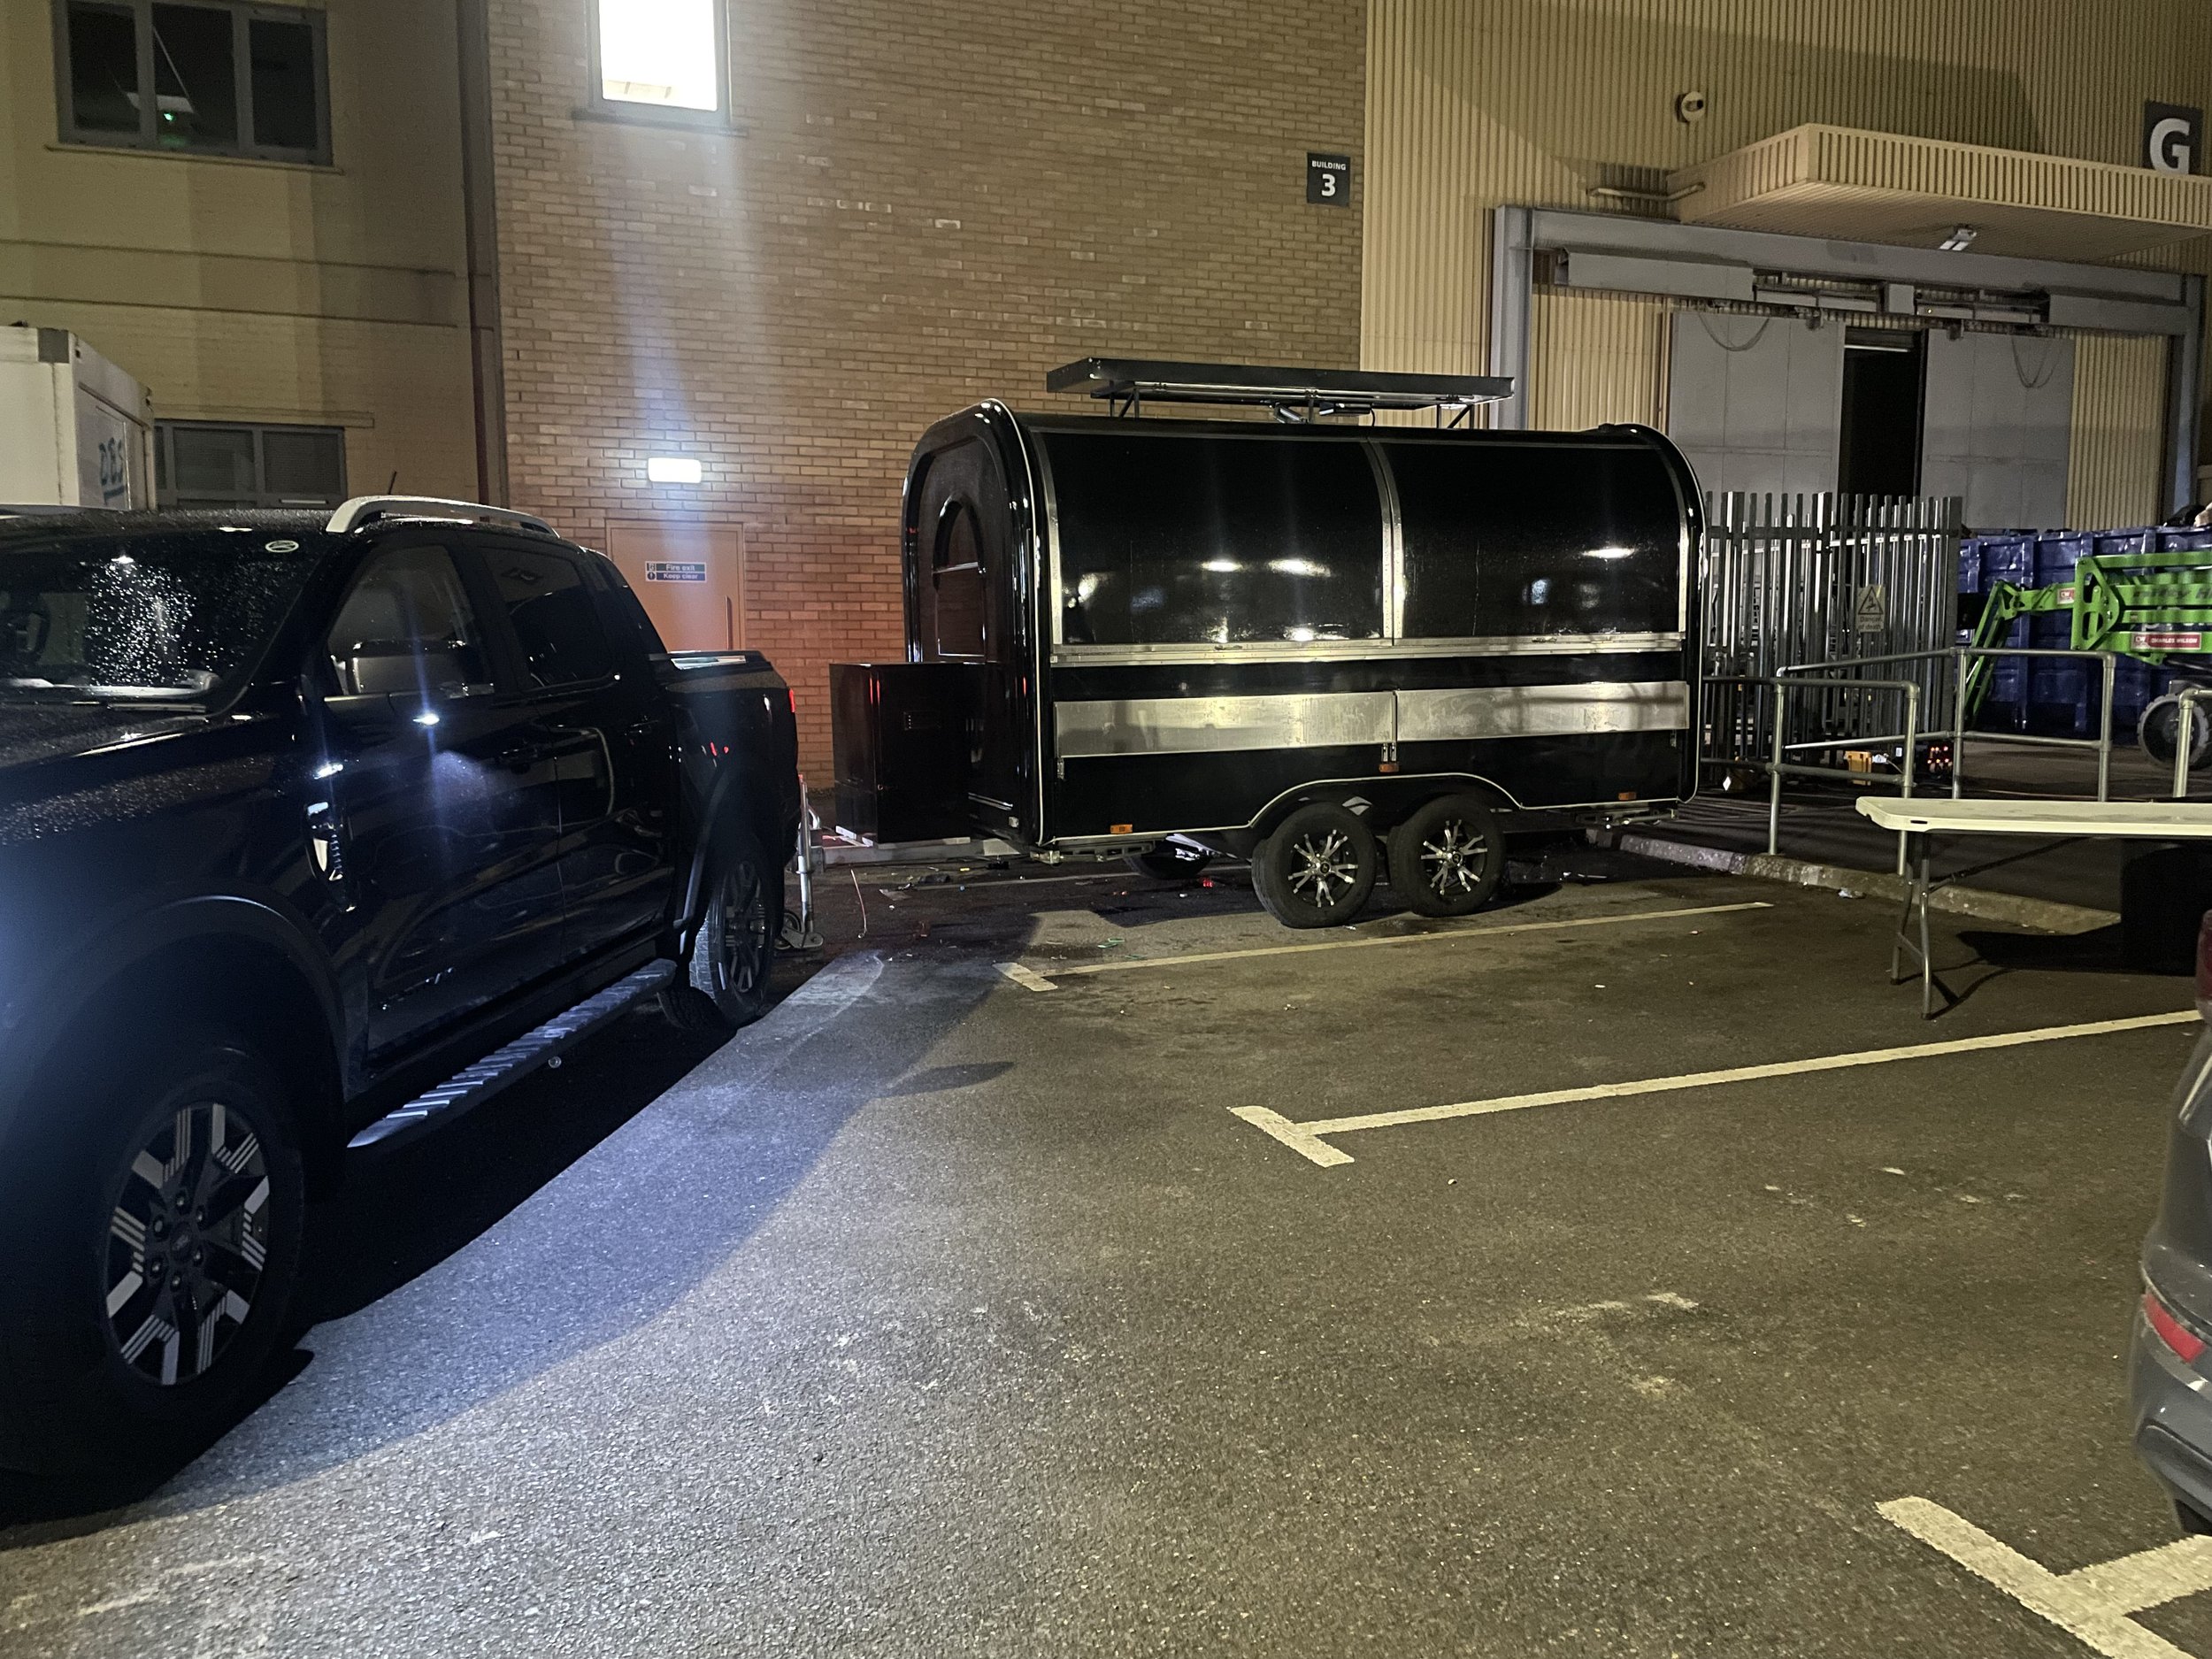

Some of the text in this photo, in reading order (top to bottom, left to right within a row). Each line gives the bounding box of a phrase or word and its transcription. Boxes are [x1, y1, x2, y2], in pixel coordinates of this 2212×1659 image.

[2149, 117, 2191, 175] G
[1311, 160, 1347, 171] BUILDING
[1321, 173, 1336, 196] 3
